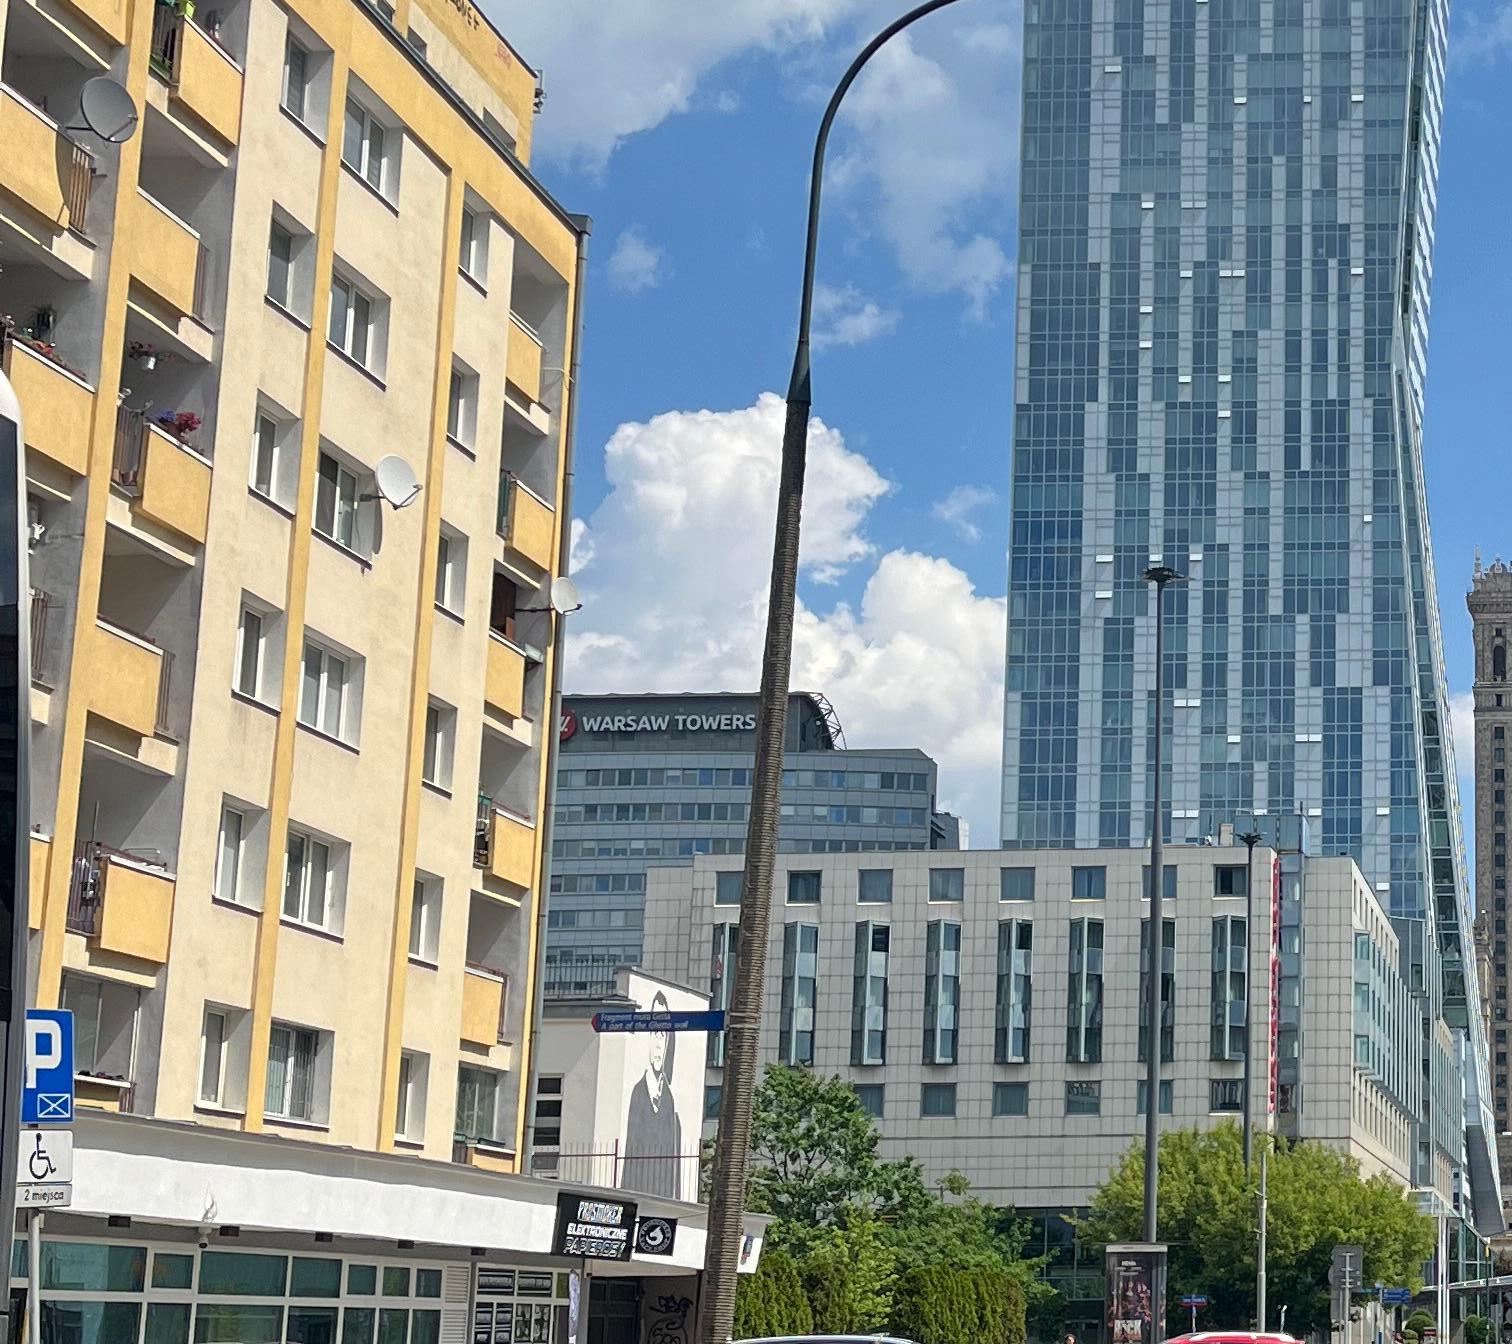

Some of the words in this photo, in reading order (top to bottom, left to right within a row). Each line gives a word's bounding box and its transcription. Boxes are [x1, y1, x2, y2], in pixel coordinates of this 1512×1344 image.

[582, 714, 670, 732] WARSAW
[674, 713, 757, 732] TOWERS
[624, 1022, 633, 1030] of
[25, 1018, 62, 1089] P
[24, 1189, 30, 1202] 2
[31, 1190, 65, 1204] miejsca
[566, 1222, 628, 1241] ELEKTRONICZNE
